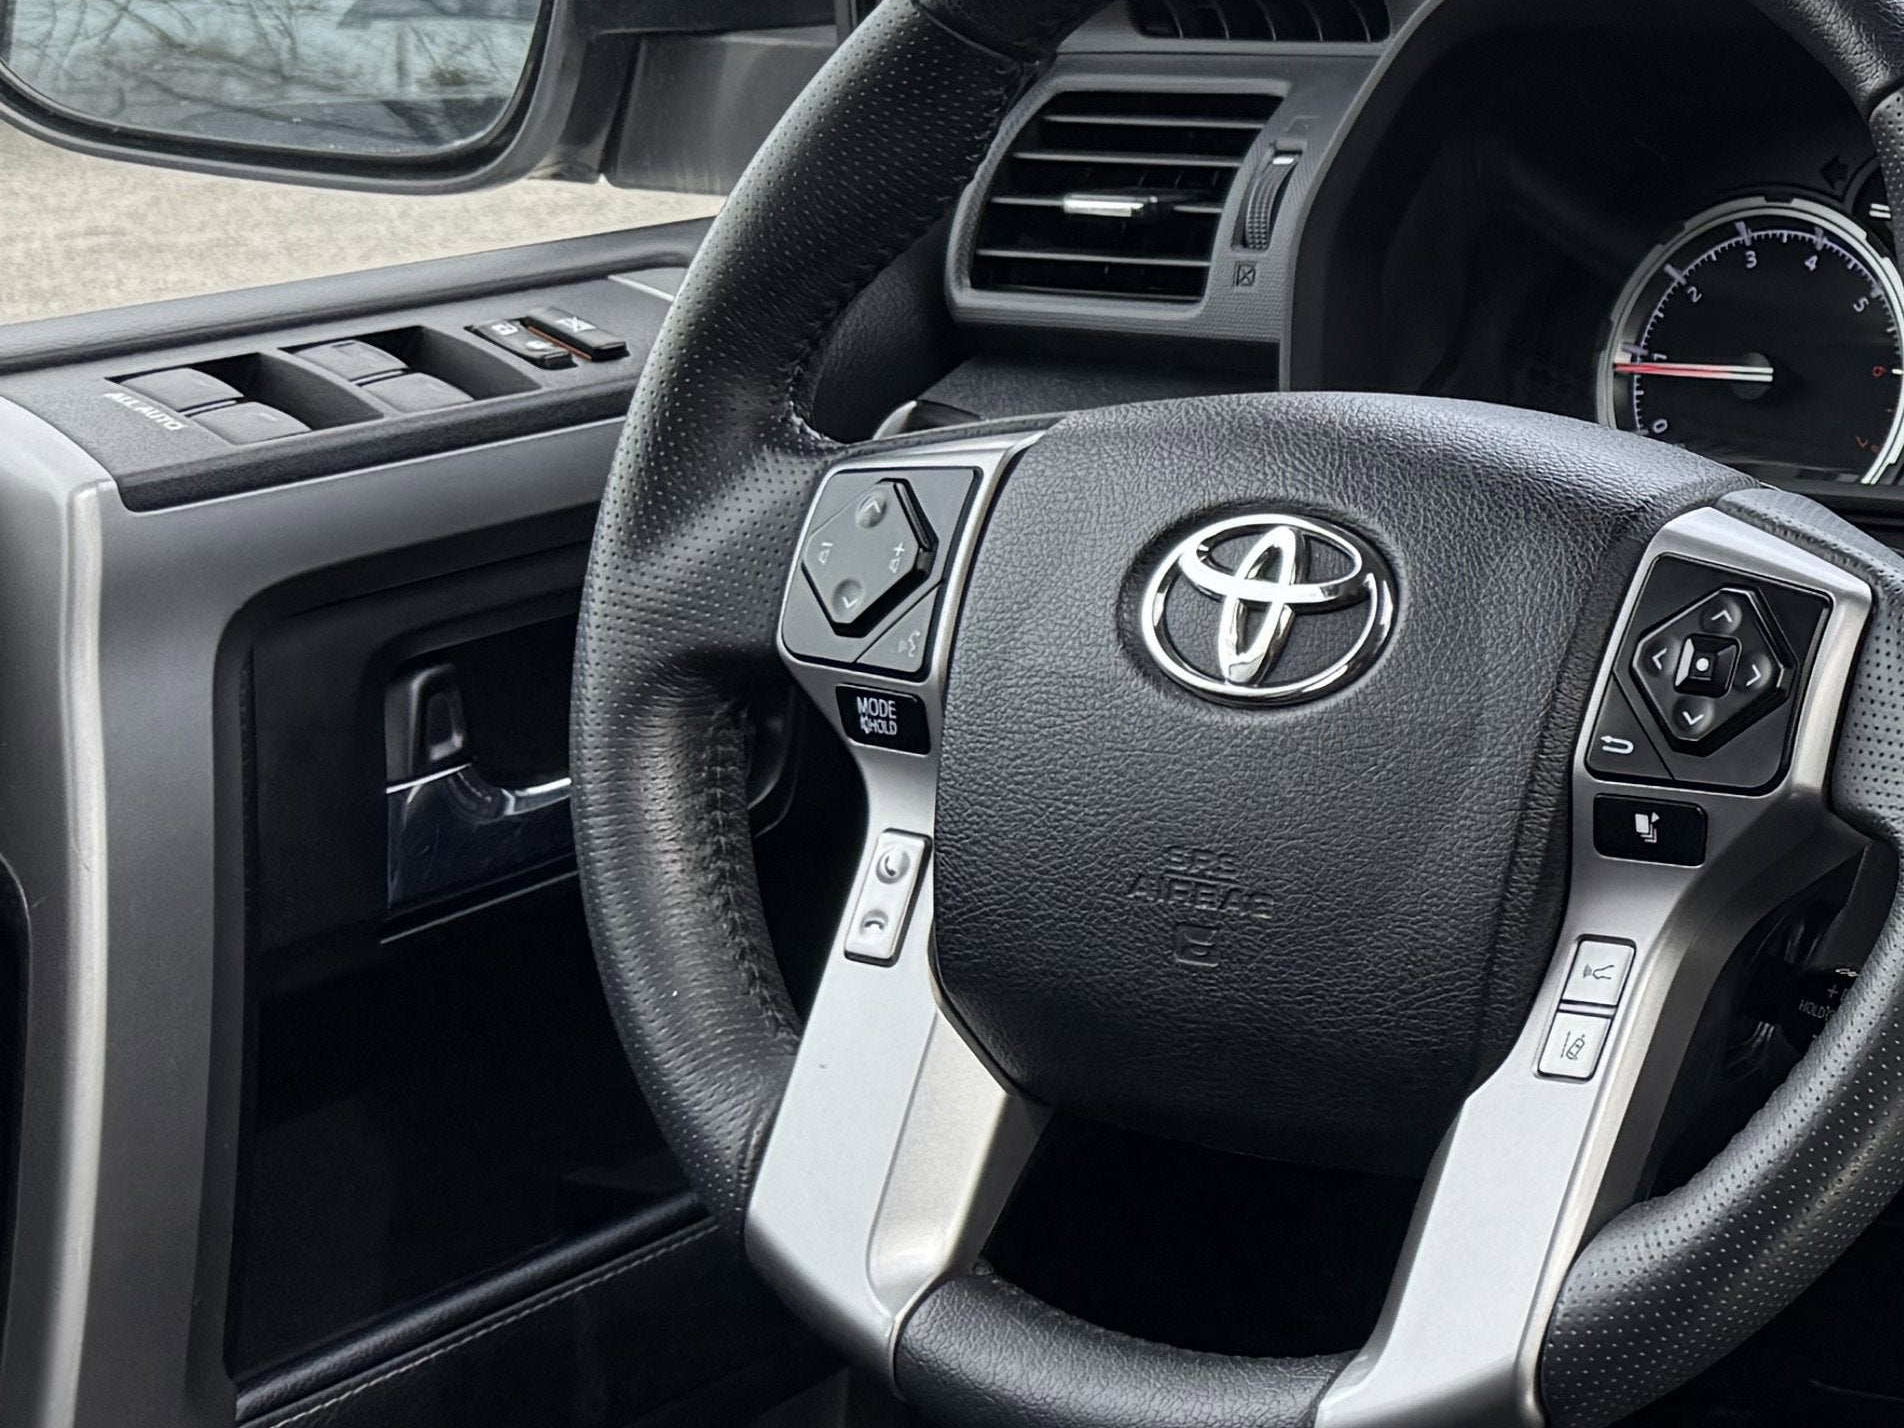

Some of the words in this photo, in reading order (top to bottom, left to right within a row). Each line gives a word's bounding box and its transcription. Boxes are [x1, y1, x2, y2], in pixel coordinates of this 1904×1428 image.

[1745, 250, 1758, 269] 3
[1804, 254, 1818, 272] 4
[1686, 286, 1703, 303] 2
[1853, 297, 1870, 313] 5
[138, 406, 189, 432] AUTO
[1652, 419, 1669, 435] 0
[856, 696, 898, 720] MODE
[1127, 874, 1278, 920] AIRBAG
